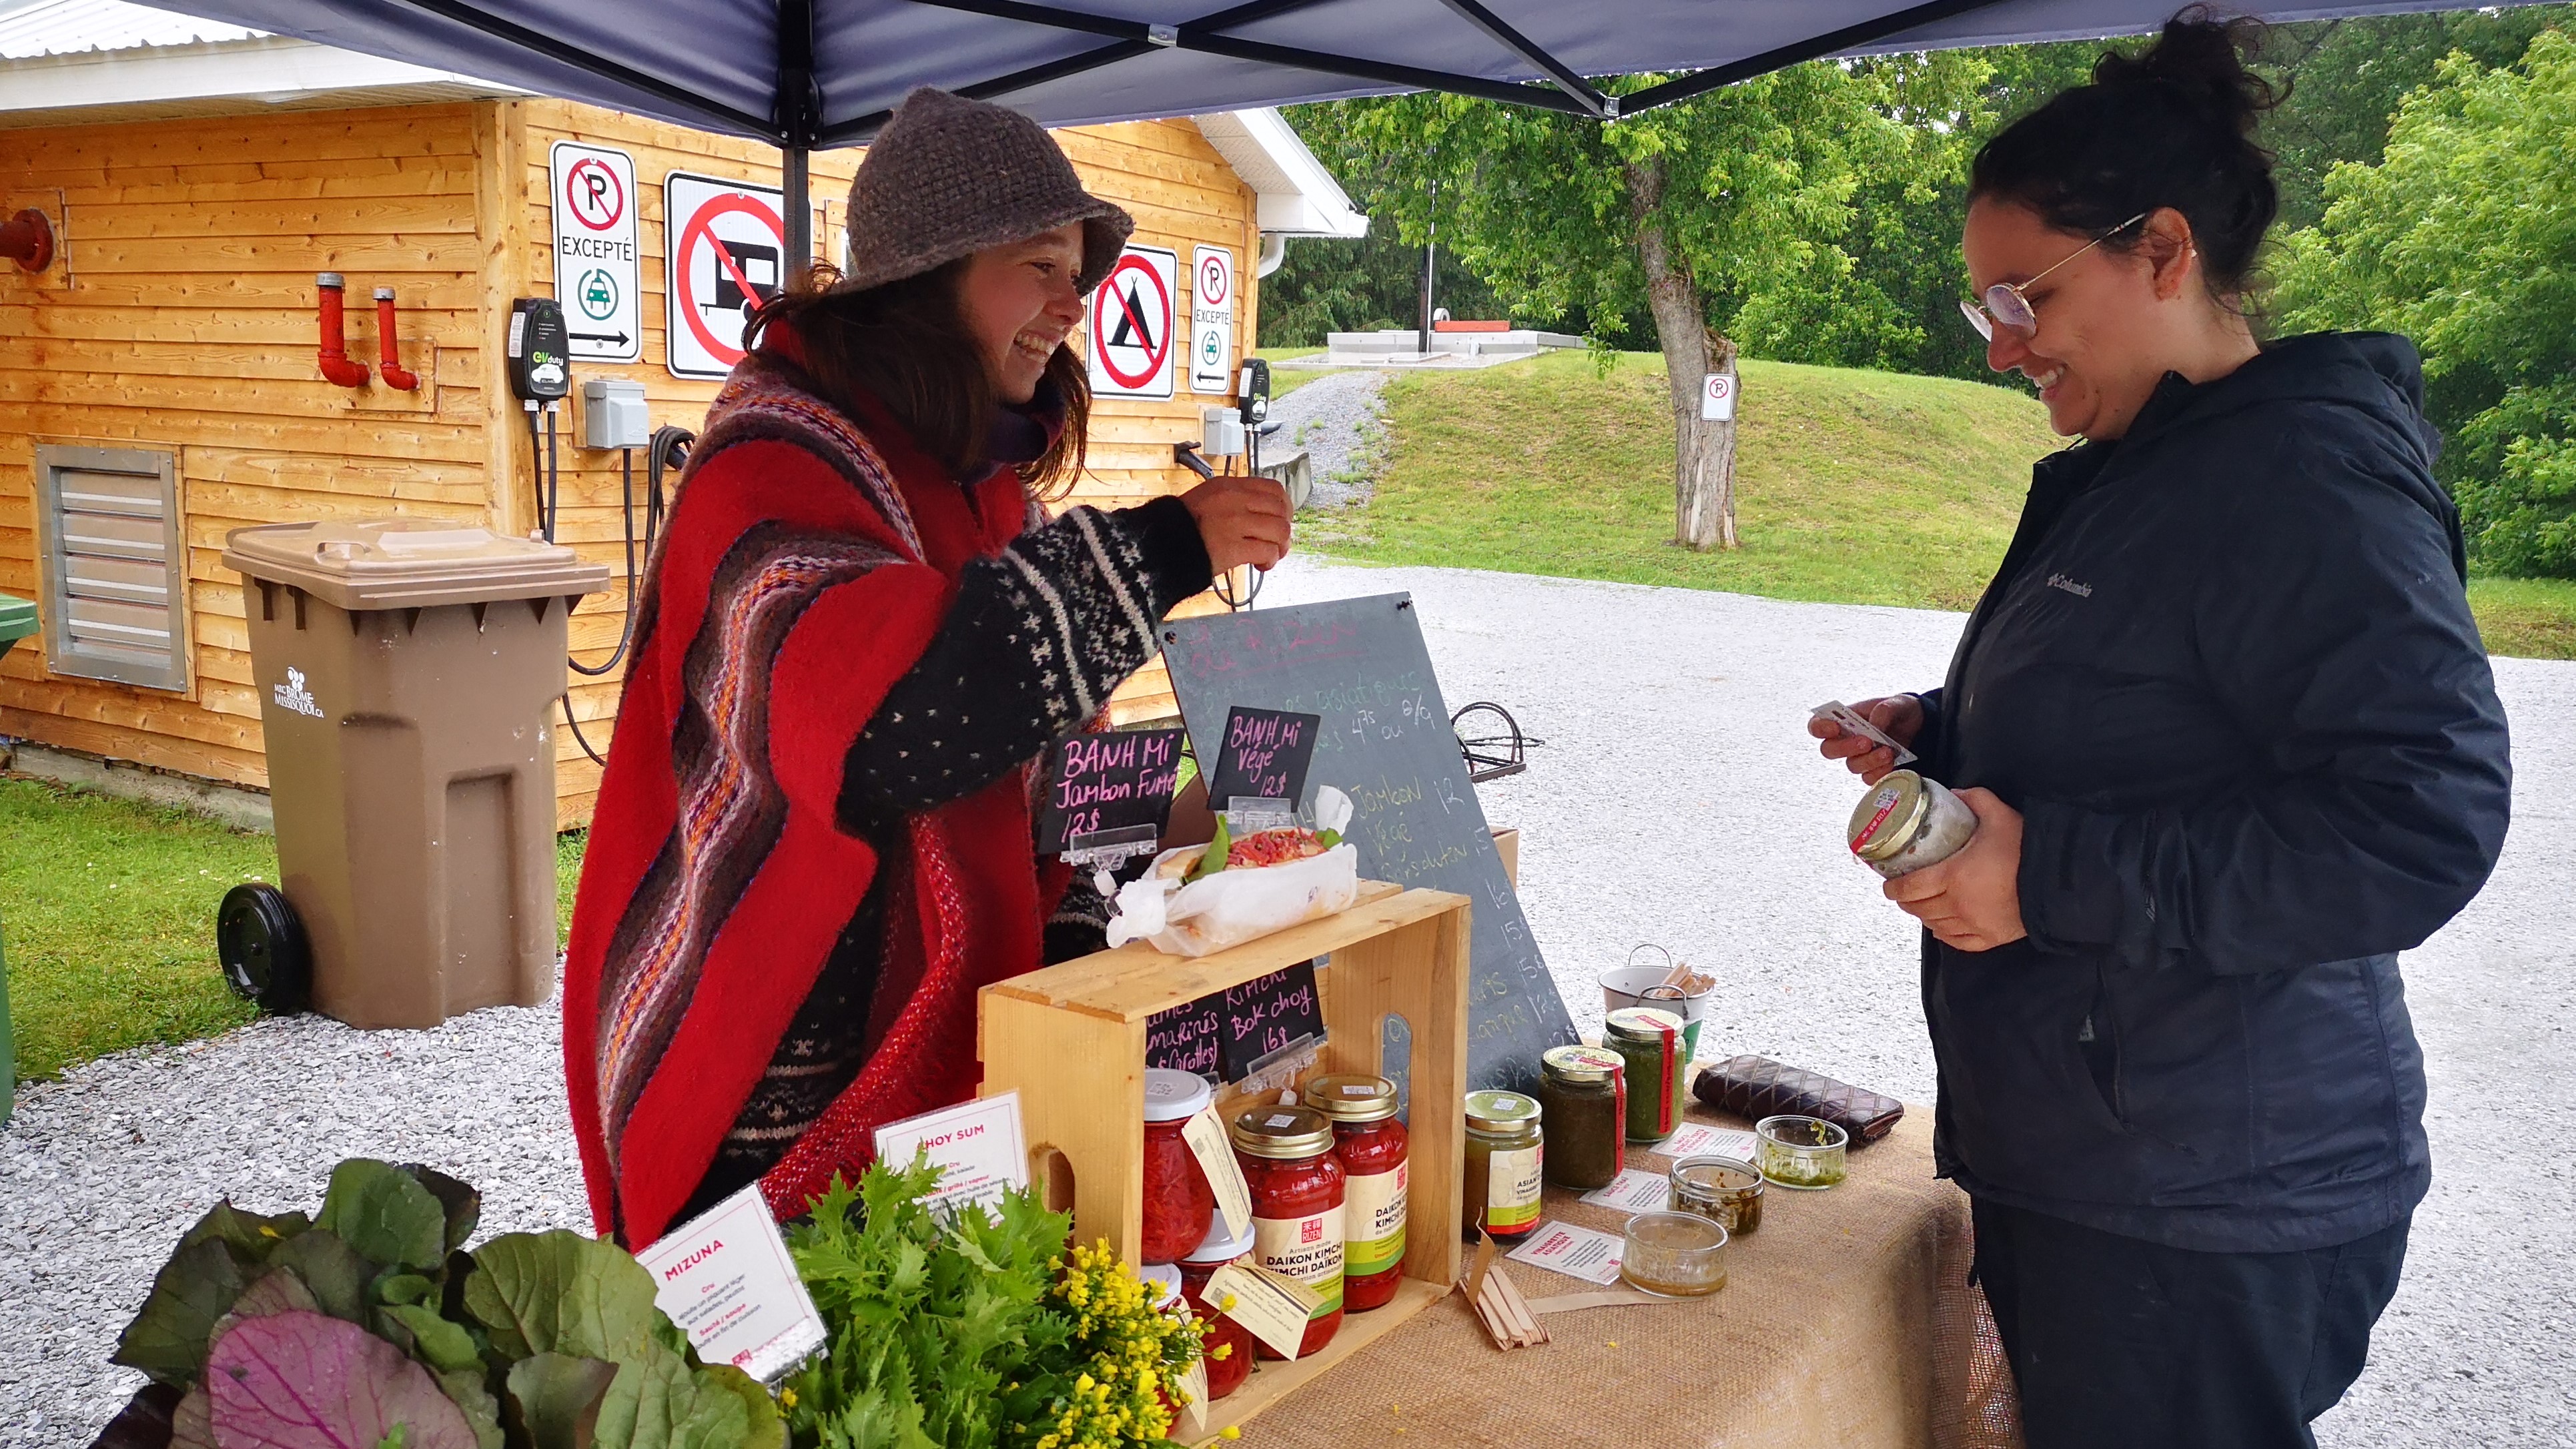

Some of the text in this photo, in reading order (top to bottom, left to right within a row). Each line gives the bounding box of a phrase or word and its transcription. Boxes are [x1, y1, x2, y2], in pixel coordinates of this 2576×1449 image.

[562, 235, 632, 262] EXCEPTÉ
[1196, 308, 1229, 326] EXCEPTÉ
[1230, 714, 1280, 749] BANH
[1063, 735, 1137, 779] BANH
[1061, 807, 1101, 844] 12$
[956, 1124, 984, 1140] SUM
[1517, 1177, 1537, 1188] ASIAN
[1375, 1199, 1402, 1218] DAIKON
[1302, 1230, 1321, 1243] RIZEN
[1531, 1231, 1566, 1255] VINAIGRETTE
[1542, 1236, 1571, 1256] ASIATIQUE
[665, 1239, 724, 1282] MIZUNA
[1266, 1253, 1312, 1266] DAIKON
[1267, 1253, 1343, 1277] IMCHI DAÏKON
